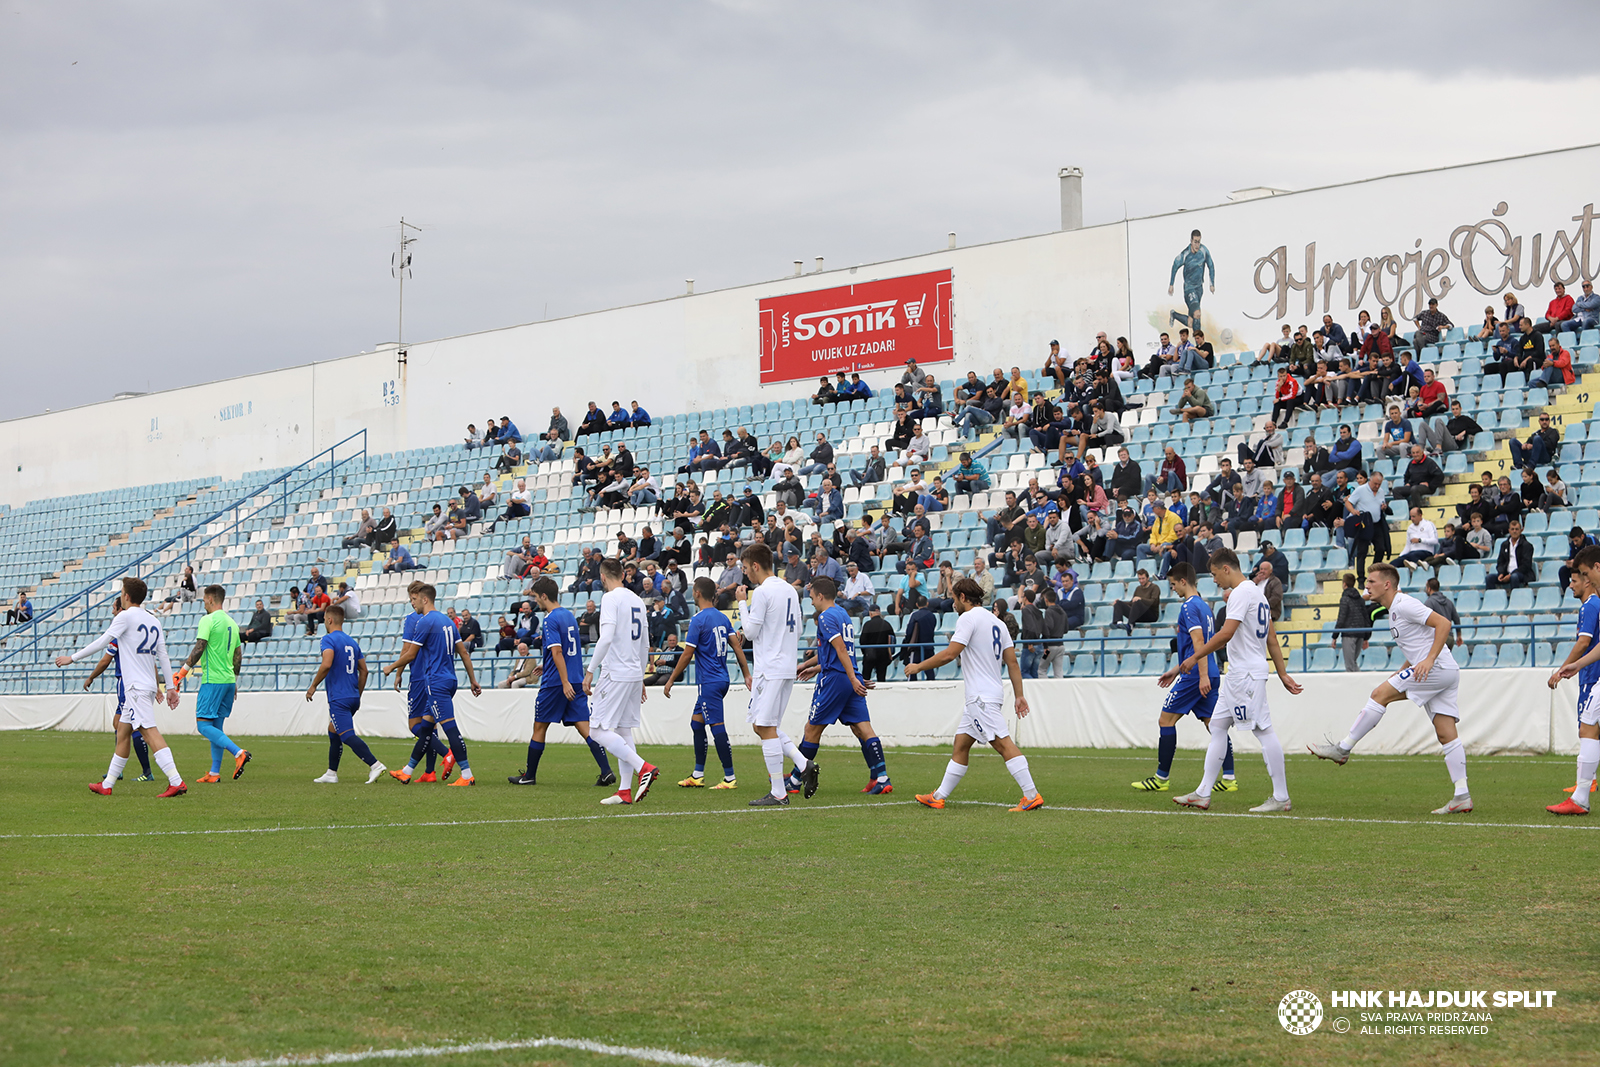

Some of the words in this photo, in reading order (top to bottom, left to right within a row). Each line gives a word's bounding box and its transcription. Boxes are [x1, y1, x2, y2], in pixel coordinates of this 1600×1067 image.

[781, 312, 790, 348] ULTRA
[811, 346, 843, 362] UVIJEK
[844, 344, 858, 356] UZ
[859, 339, 896, 355] ZADAR!
[1551, 415, 1562, 426] 11
[1437, 508, 1445, 518] 7
[631, 606, 642, 640] 5
[786, 597, 796, 634] 4
[1313, 608, 1321, 620] 3
[136, 623, 160, 656] 22
[228, 626, 232, 653] 1
[443, 625, 454, 655] 11
[567, 625, 577, 656] 5
[712, 625, 727, 657] 16
[992, 625, 1002, 660] 8
[1282, 634, 1289, 647] 2
[344, 645, 355, 674] 3
[974, 718, 983, 733] 8
[1234, 705, 1247, 721] 97
